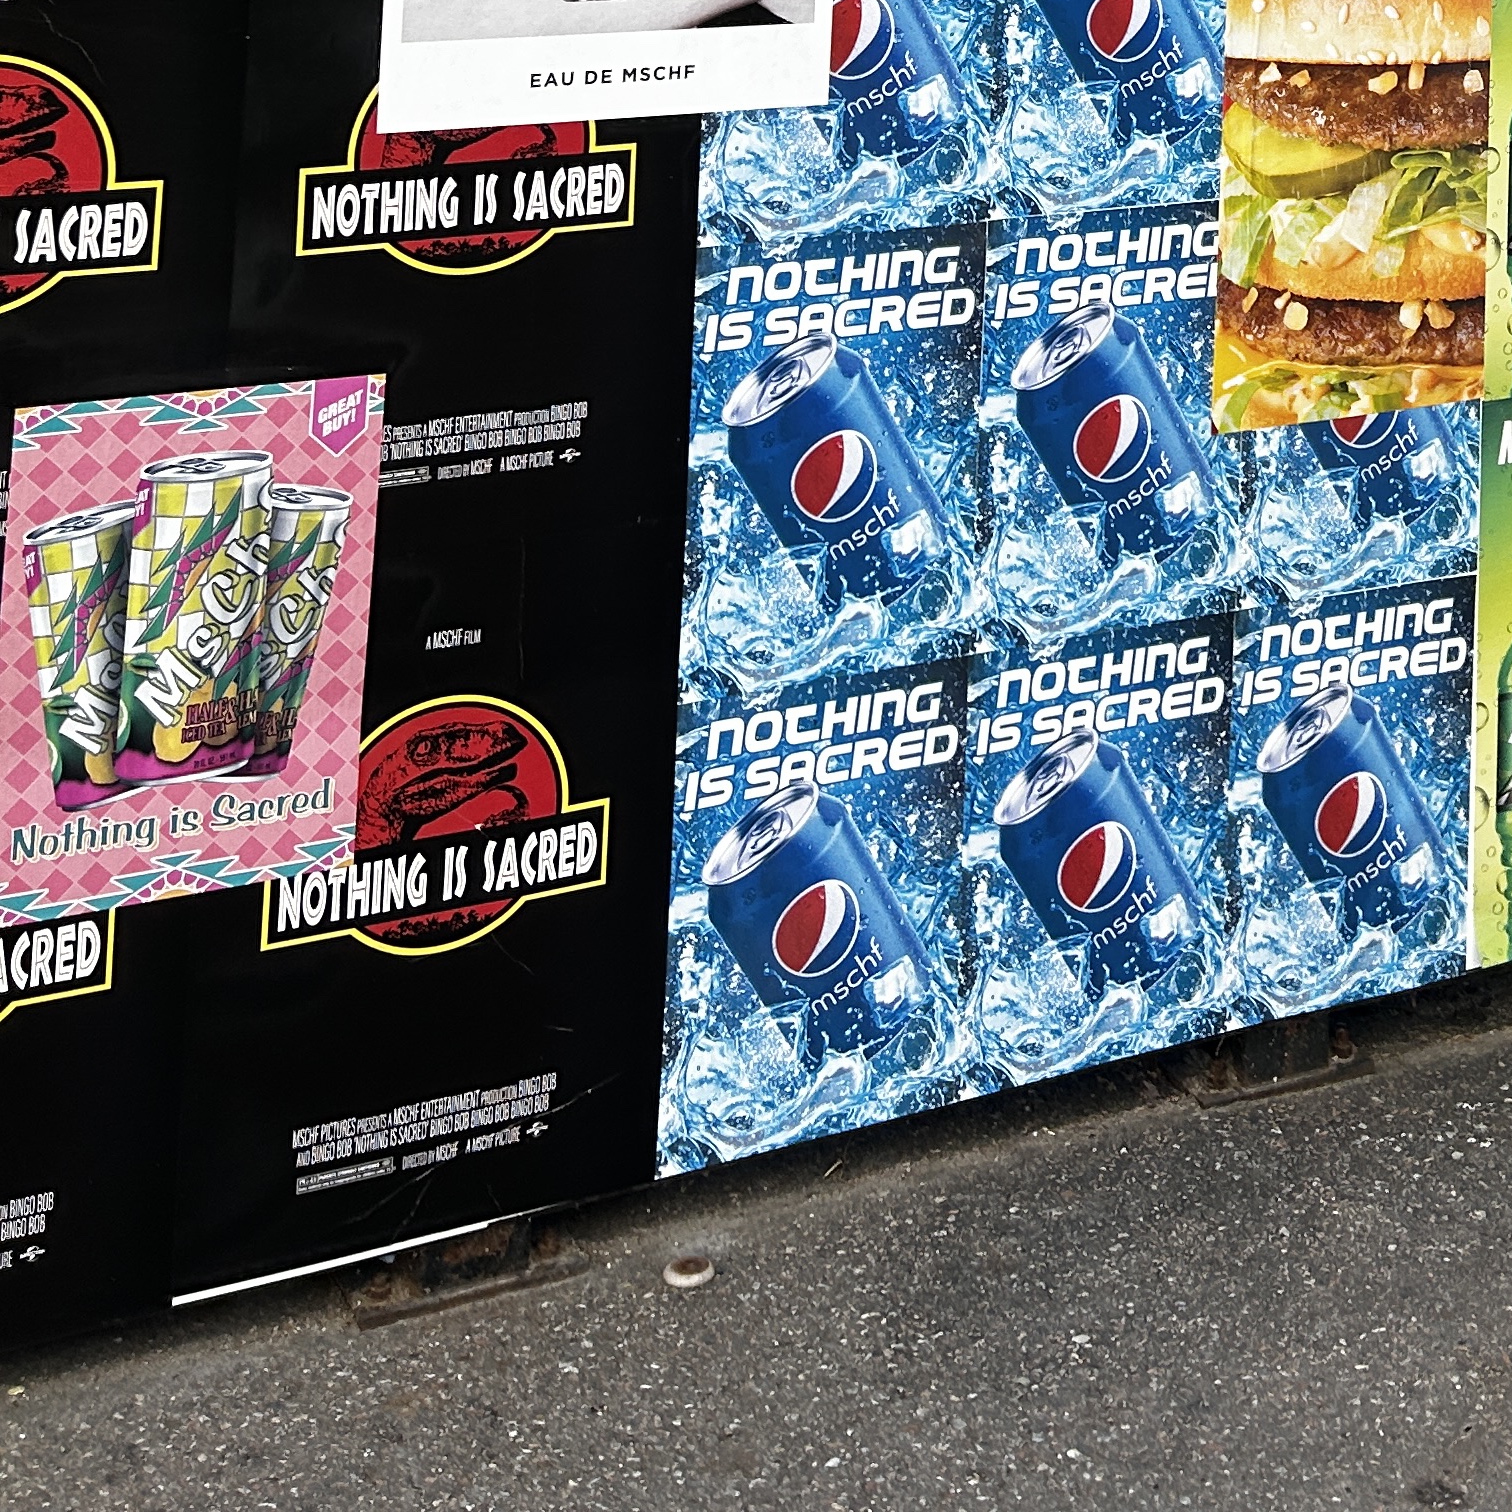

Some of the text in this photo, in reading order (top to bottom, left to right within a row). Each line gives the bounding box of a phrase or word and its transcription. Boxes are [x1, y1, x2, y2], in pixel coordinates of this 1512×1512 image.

[530, 65, 697, 88] EAU DE MSCHF
[847, 50, 919, 119] mschf
[1121, 40, 1185, 98] mschf
[13, 201, 149, 266] SACRED
[311, 163, 625, 241] NOTHING IS SACRED
[726, 246, 959, 304] NOTHING
[1014, 221, 1219, 275] NOTHING
[703, 289, 976, 354] IS SACRED
[993, 262, 1218, 323] IS SACRE
[318, 389, 363, 423] GREAT
[322, 408, 356, 437] BUY!
[1361, 418, 1420, 483] mschf
[1108, 455, 1174, 520] mschf
[829, 491, 903, 559] mschf
[425, 636, 431, 650] A
[433, 628, 463, 649] MSCHF
[1260, 597, 1455, 660] NOTHING
[996, 636, 1211, 709] NOTHING
[1239, 637, 1468, 708] IS SACRED
[706, 682, 944, 762] NOTHING
[976, 678, 1227, 758] IS SACRED
[683, 726, 958, 813] IS SACRED
[10, 778, 334, 866] Nothing is Sacred
[276, 820, 597, 934] NOTHING IS SACRED
[1347, 830, 1408, 892] mschf
[1094, 877, 1160, 949] mschf
[0, 918, 101, 992] CRED
[811, 936, 884, 1015] mschf
[292, 1124, 319, 1149] MSCHF
[321, 1117, 356, 1144] PICTURES
[393, 1103, 419, 1127] MSCHF
[421, 1090, 480, 1120] ENTERTAINMENT
[519, 1076, 540, 1097] BINGO
[542, 1072, 556, 1092] BOB
